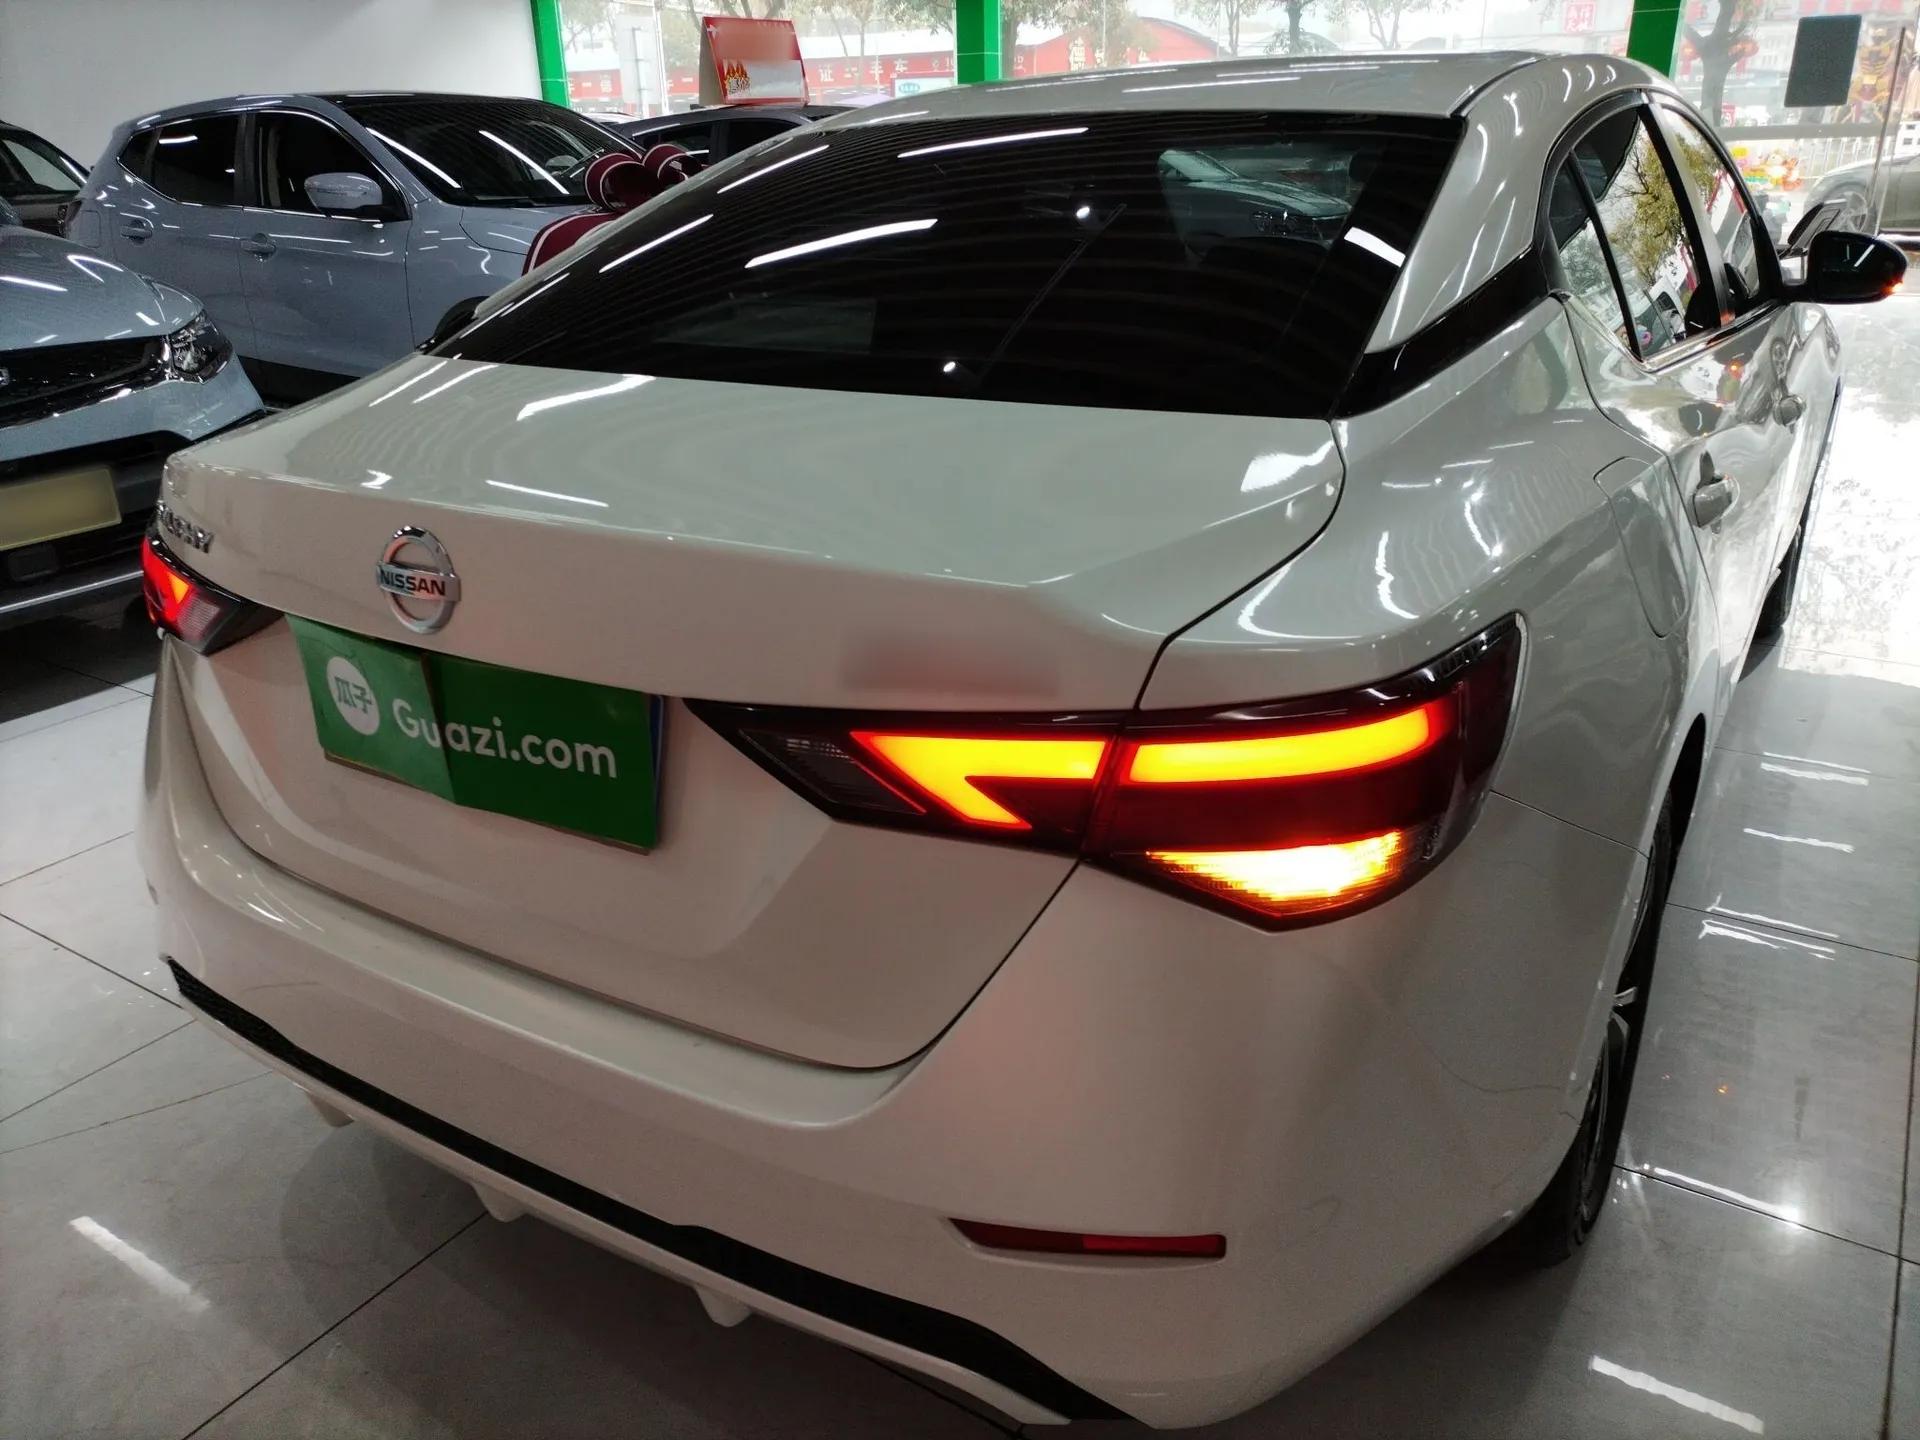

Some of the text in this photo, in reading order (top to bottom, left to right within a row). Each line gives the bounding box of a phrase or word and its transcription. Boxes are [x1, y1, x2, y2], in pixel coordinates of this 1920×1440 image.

[380, 568, 446, 597] NISSAN
[334, 676, 373, 714] 瓜子
[392, 698, 618, 779] Guazi.com
